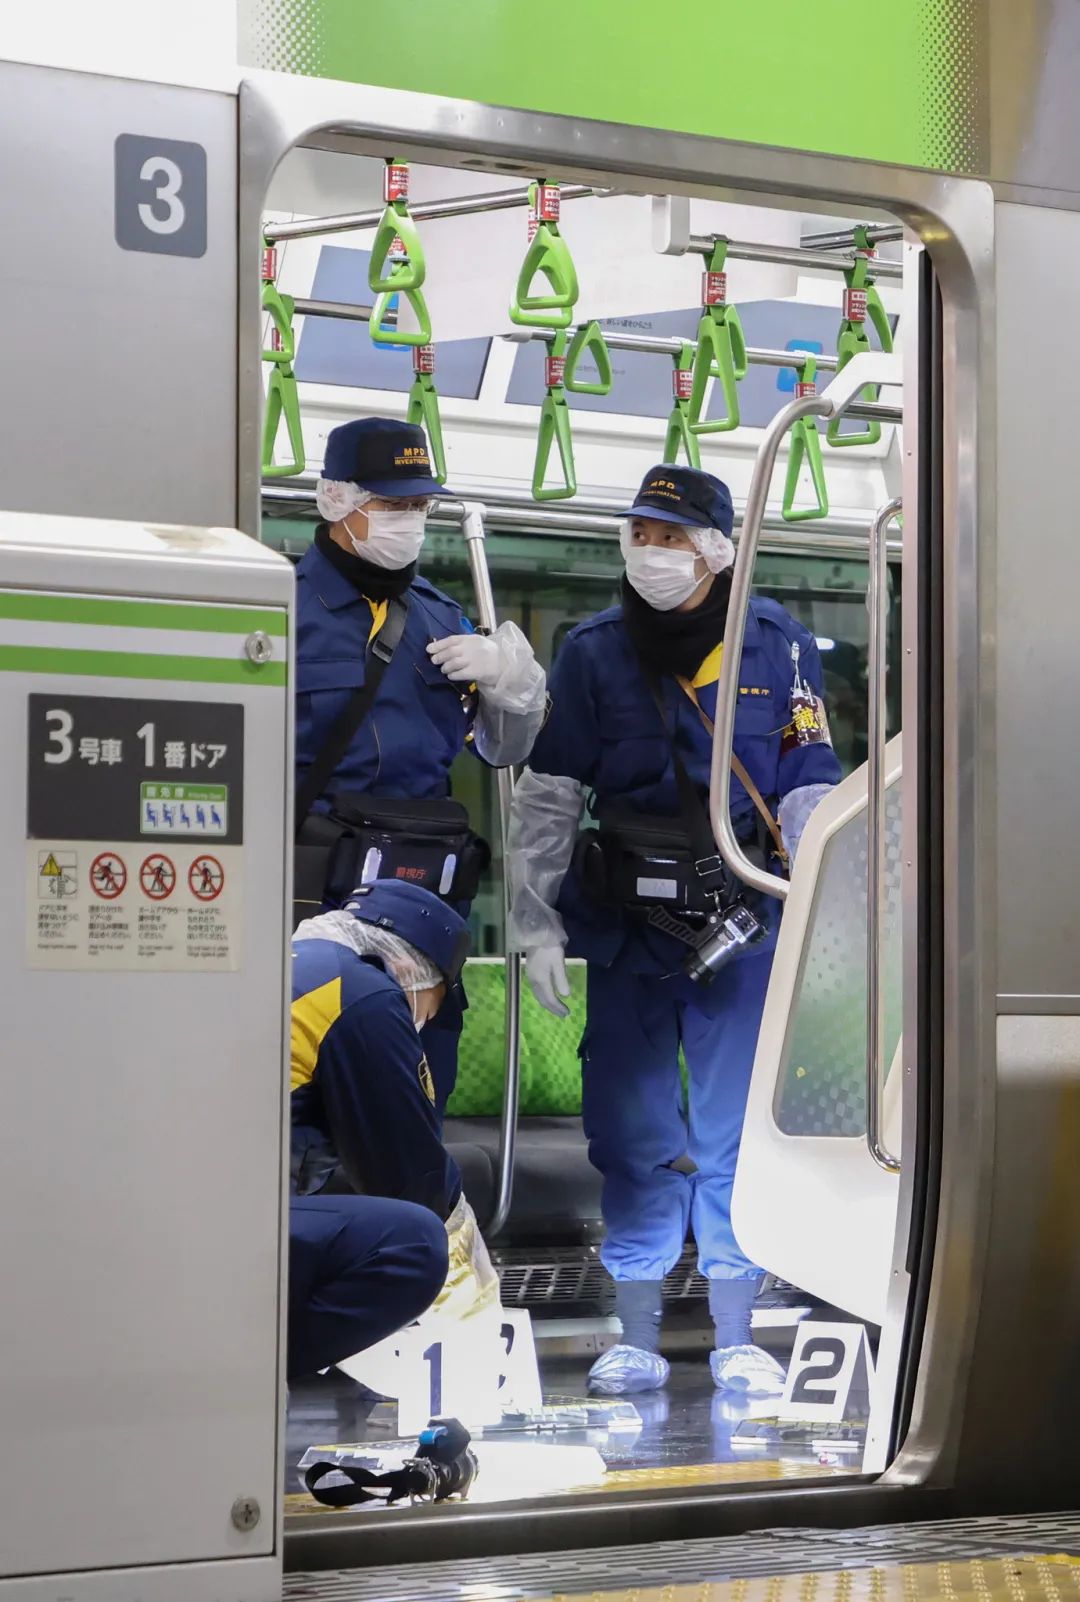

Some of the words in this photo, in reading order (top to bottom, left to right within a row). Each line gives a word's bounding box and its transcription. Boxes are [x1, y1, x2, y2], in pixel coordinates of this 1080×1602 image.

[138, 155, 185, 235] 3
[44, 709, 123, 766] 3号車
[136, 722, 228, 769] 1番ドア
[423, 1342, 442, 1418] 1
[790, 1337, 846, 1404] 2
